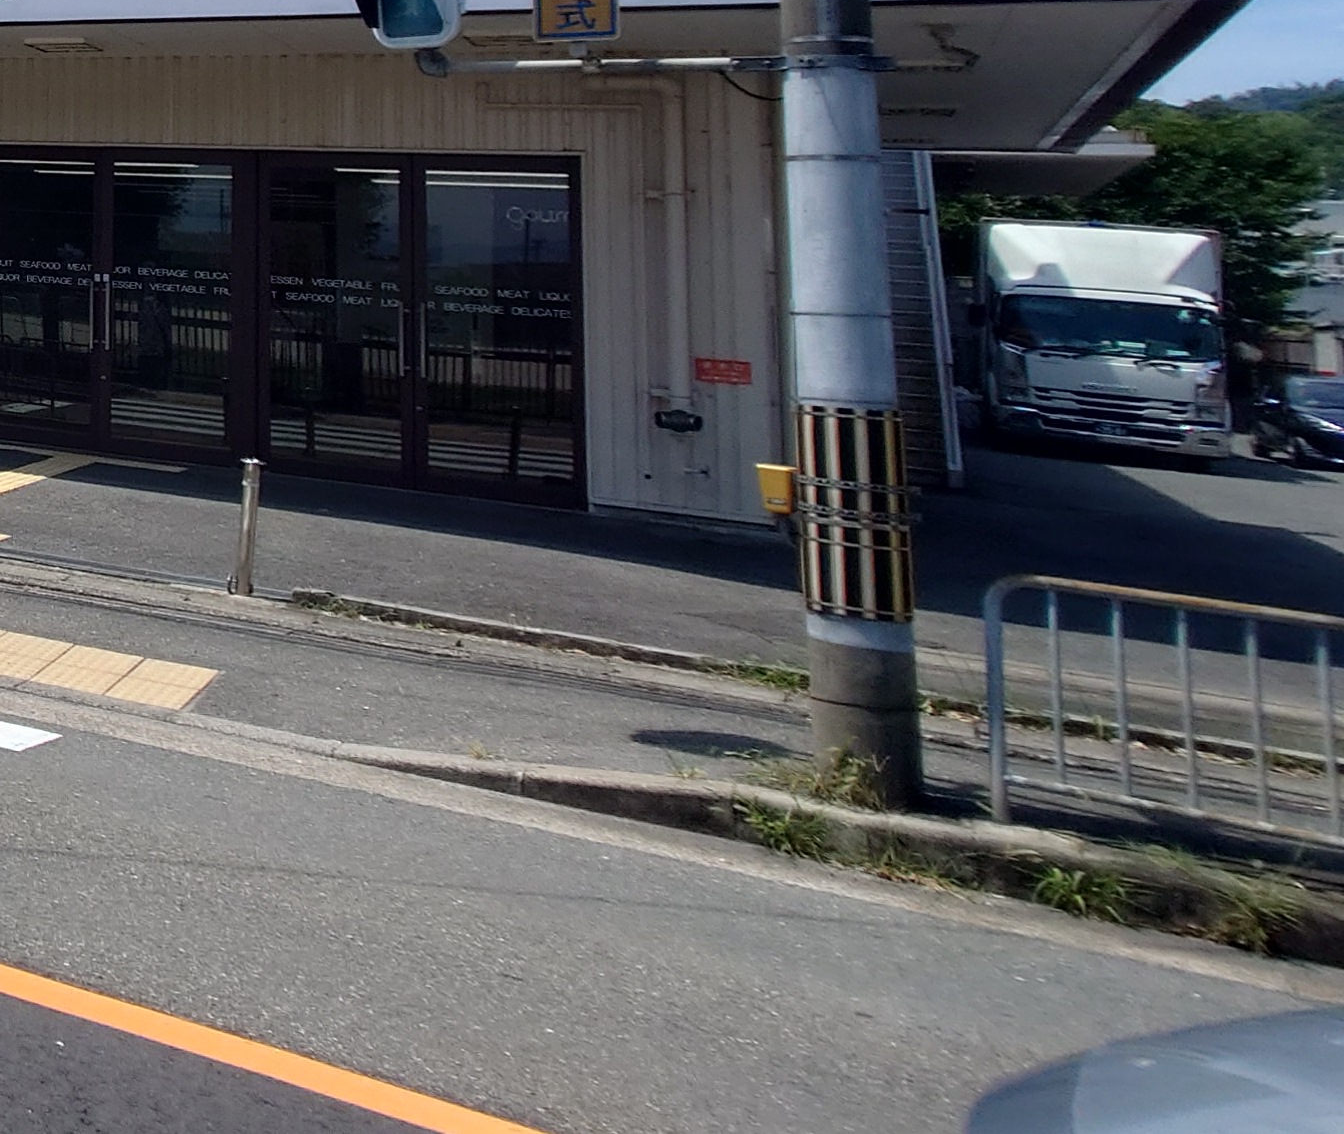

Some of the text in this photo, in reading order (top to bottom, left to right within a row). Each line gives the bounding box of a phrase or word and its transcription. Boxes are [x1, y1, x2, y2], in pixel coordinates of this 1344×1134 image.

[19, 260, 62, 271] SEAFOOD
[66, 263, 93, 272] MEAT
[137, 267, 189, 278] BEVERAGE
[25, 274, 73, 286] BEVERAGE
[310, 276, 374, 291] VEGETABLE
[148, 282, 207, 295] VEGETABLE
[433, 285, 490, 297] SEAFOOD
[496, 288, 530, 300] MEAT
[285, 291, 336, 303] SEAFOOD
[342, 294, 373, 306] MEAT
[442, 301, 506, 316] BEVERAGE
